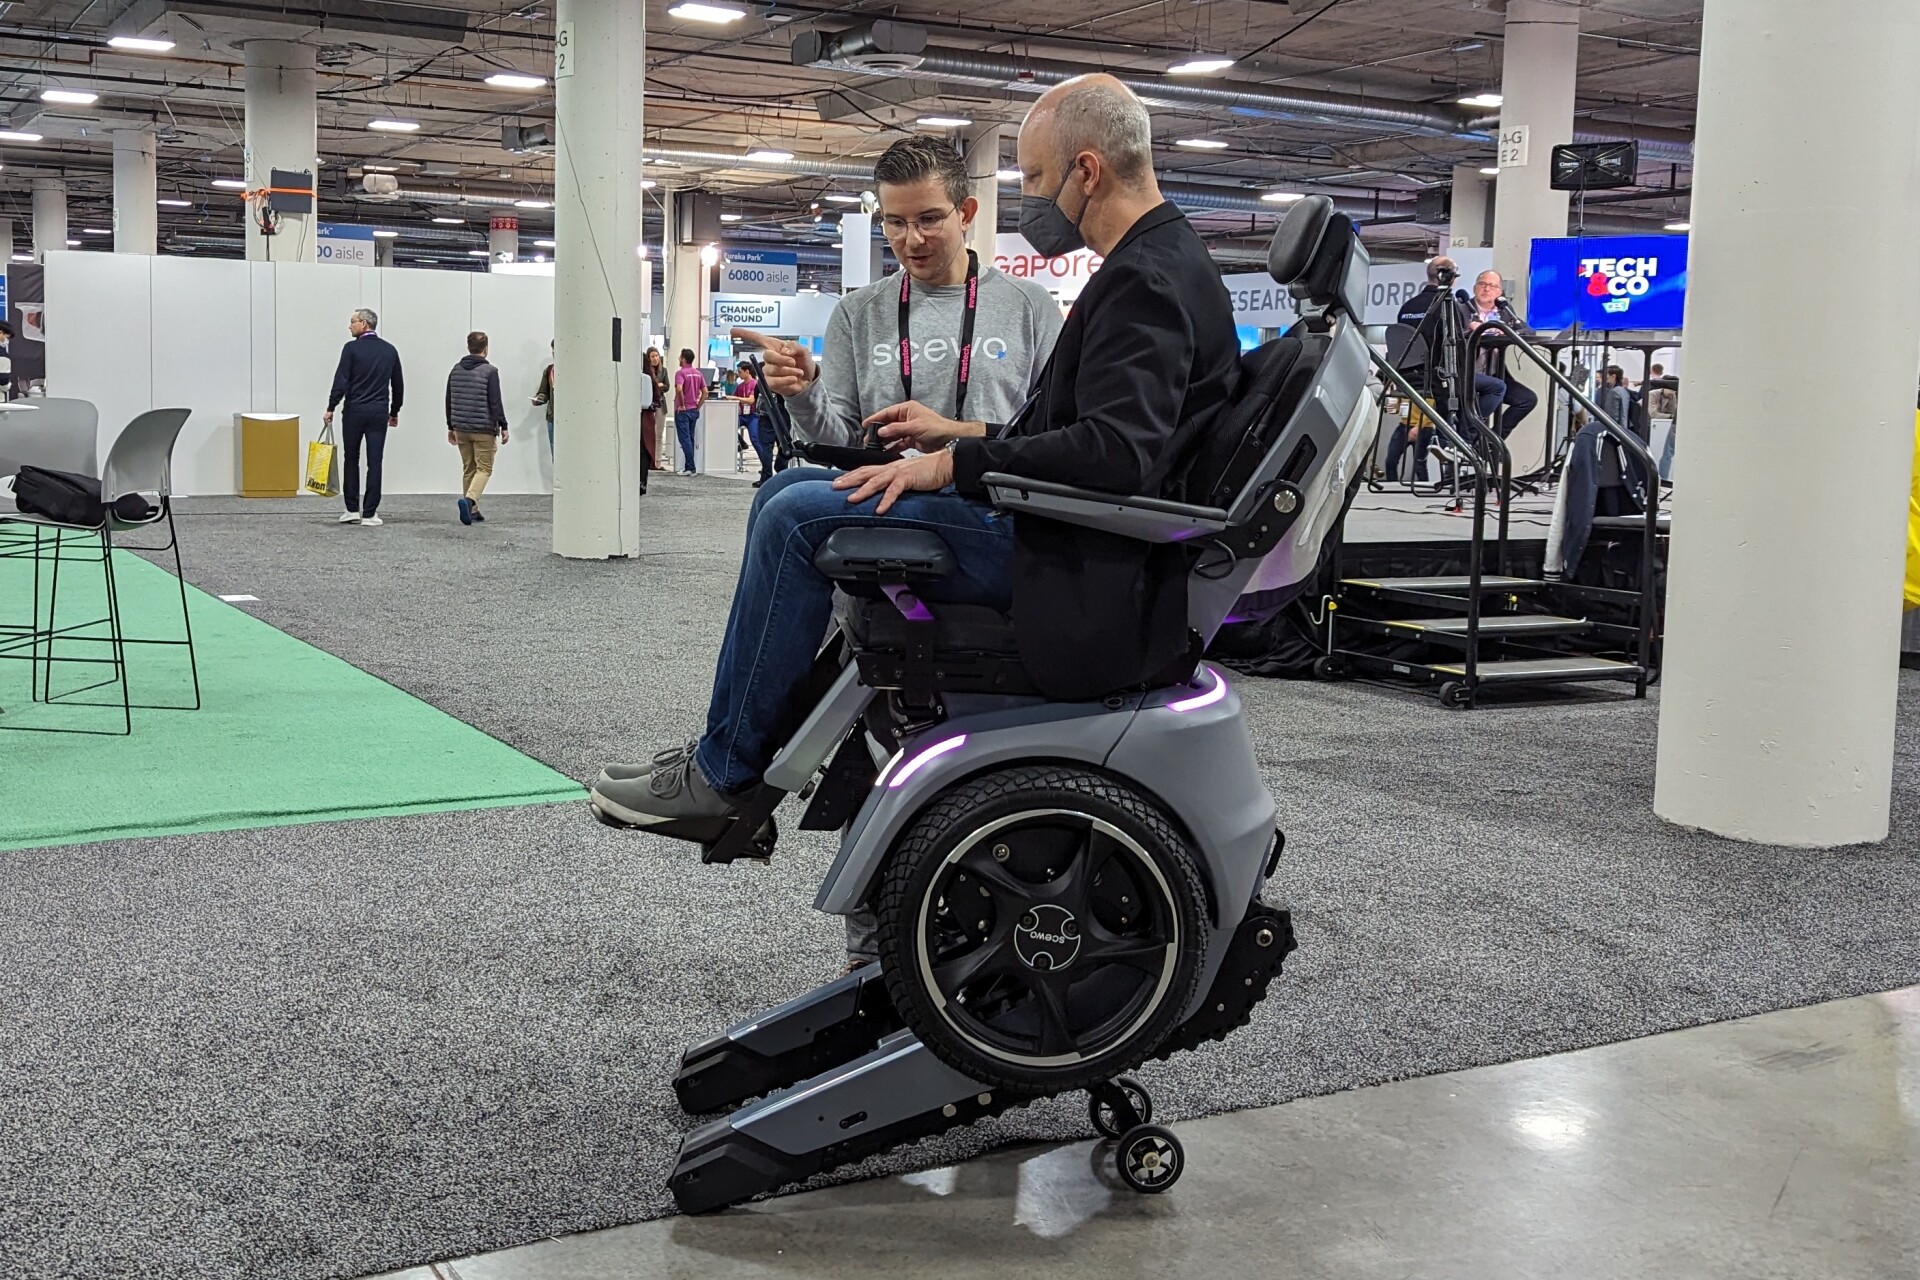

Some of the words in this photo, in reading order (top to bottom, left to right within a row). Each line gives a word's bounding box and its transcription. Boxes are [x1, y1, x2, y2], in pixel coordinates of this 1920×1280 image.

[1501, 131, 1522, 145] A-G
[1510, 148, 1519, 161] 2
[335, 246, 364, 260] aisle
[723, 252, 746, 261] Eureka
[1580, 257, 1658, 278] TECH
[728, 269, 765, 282] 60800
[766, 271, 790, 283] aisle
[1365, 281, 1428, 306] ORR
[720, 314, 763, 323] GROUND
